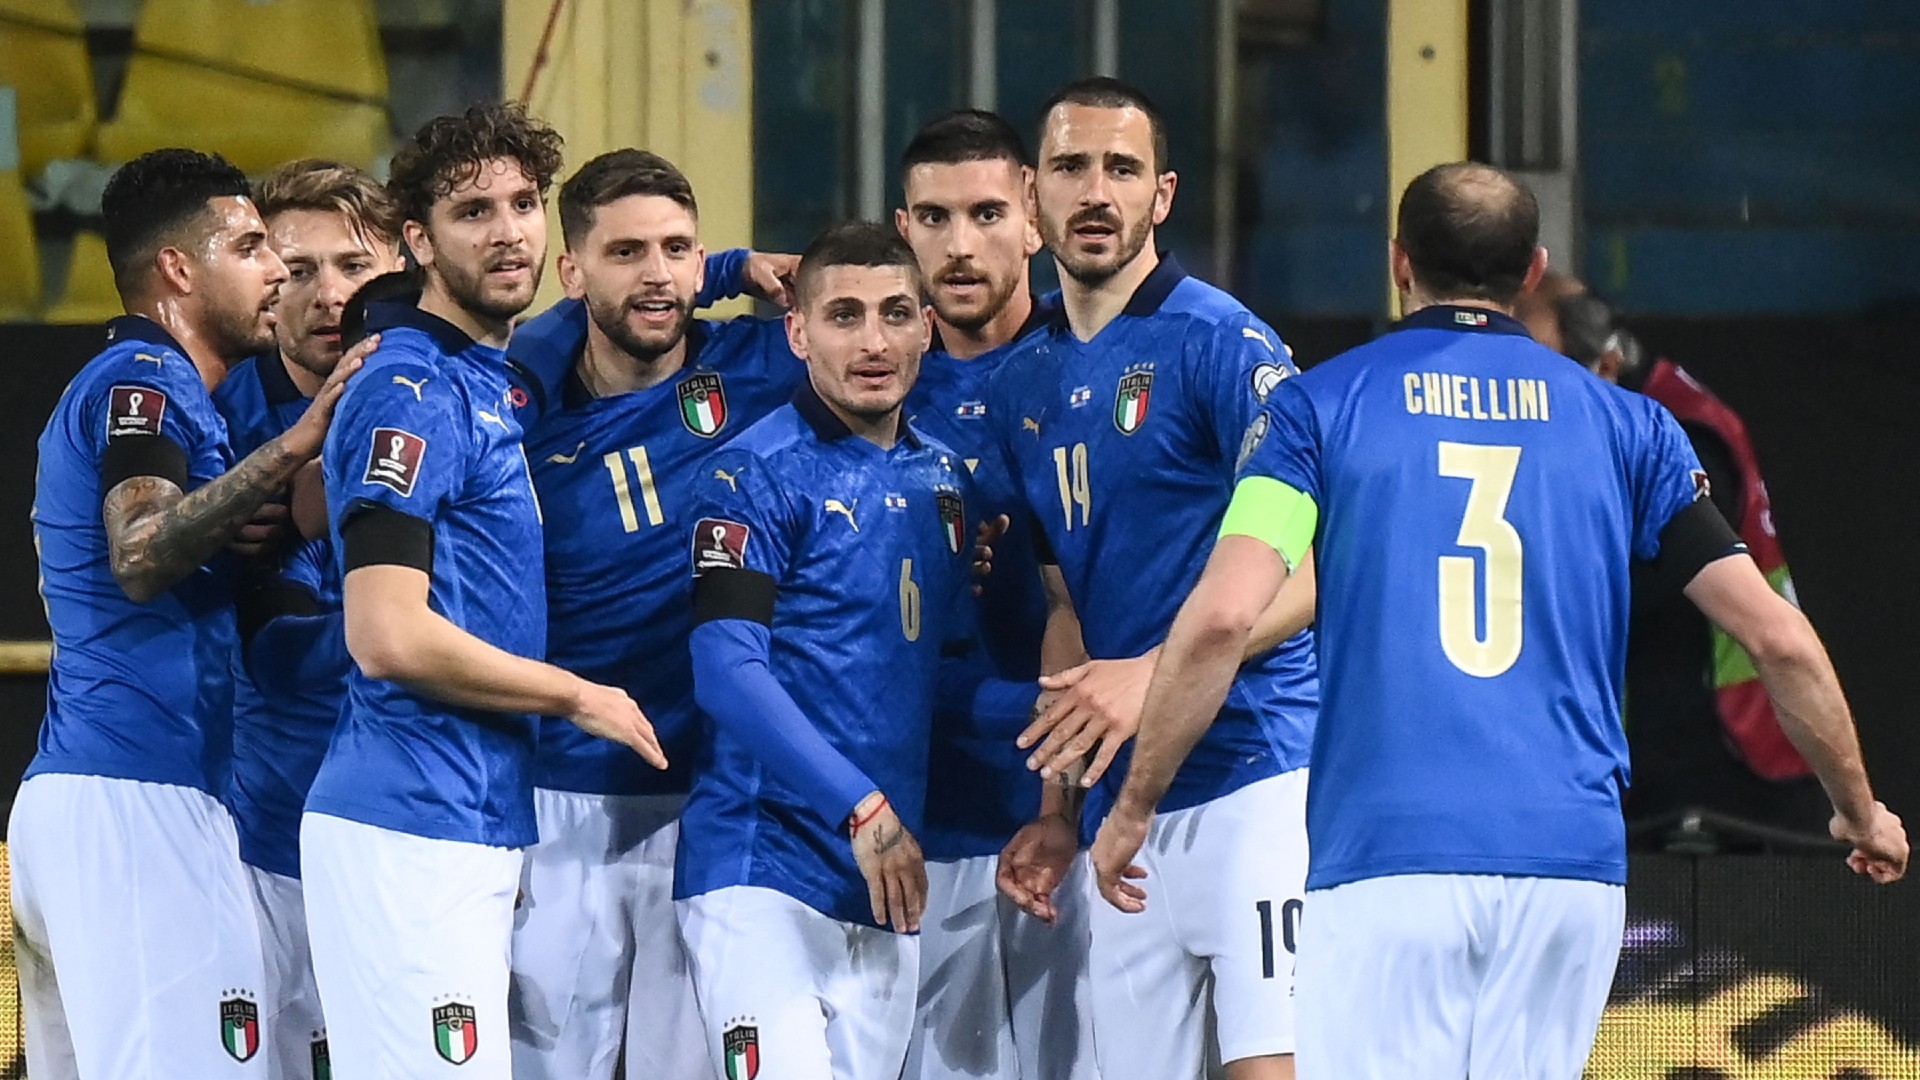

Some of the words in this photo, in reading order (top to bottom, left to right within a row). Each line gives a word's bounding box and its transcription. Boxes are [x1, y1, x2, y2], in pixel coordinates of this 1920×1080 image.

[680, 377, 718, 394] ITALIA
[1122, 376, 1150, 388] ITALIA
[1403, 372, 1550, 421] CHIELLINI
[603, 445, 665, 534] 11
[1053, 442, 1091, 531] 19
[1438, 440, 1524, 678] 3
[899, 558, 921, 642] 6
[223, 1003, 256, 1015] ITALIA
[434, 1006, 474, 1020] ITALIA
[725, 1029, 756, 1046] ITALIA
